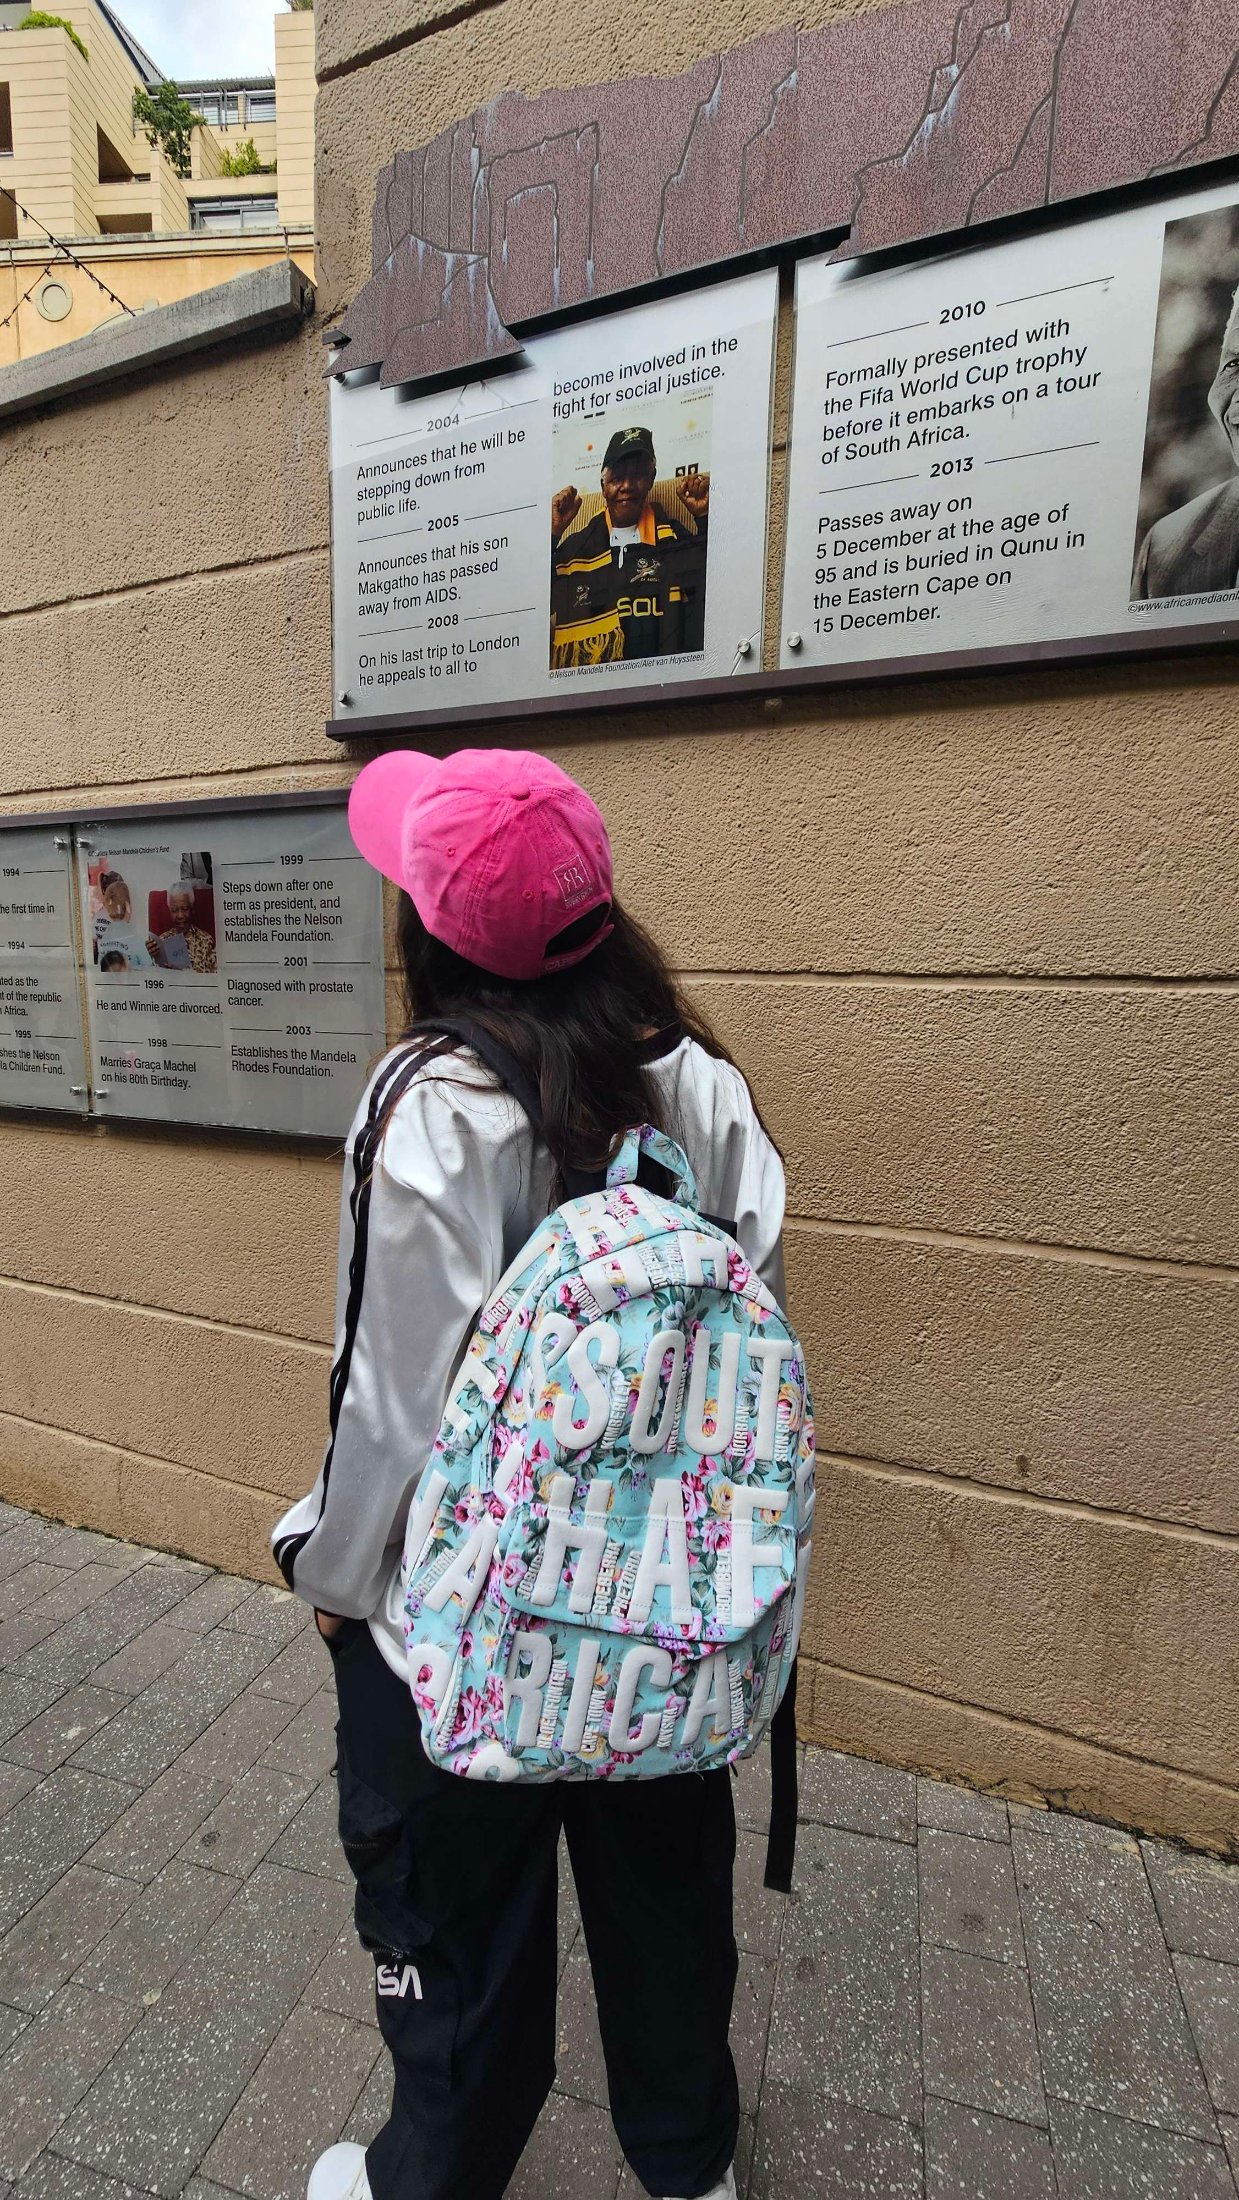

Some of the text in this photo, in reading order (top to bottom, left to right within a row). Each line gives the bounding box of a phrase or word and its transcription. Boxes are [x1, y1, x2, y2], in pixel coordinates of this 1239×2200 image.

[939, 300, 985, 325] 2010
[554, 338, 738, 396] become involved in the
[826, 319, 1069, 389] Formally presented with
[553, 396, 585, 419] fight
[590, 392, 611, 408] for
[616, 376, 661, 402] social
[666, 366, 724, 394] justice.
[824, 346, 1087, 415] the Fifa World Cup trophy
[823, 372, 1101, 441] before it embarks on a tour
[427, 413, 460, 432] 2004
[357, 430, 525, 480] Announces that he will be
[822, 426, 969, 464] of South Africa.
[930, 457, 973, 478] 2013
[357, 462, 484, 501] stepping down from
[358, 498, 420, 525] public life.
[428, 514, 459, 532] 2005
[819, 497, 972, 534] Passes away on
[816, 503, 1069, 559] 5 December at the age of
[358, 537, 508, 575] Announces that his son
[815, 533, 1084, 584] 95 and is buried in Qunu in
[359, 557, 498, 595] Makgatho has passed
[359, 586, 461, 616] away from AIDS.
[814, 571, 1011, 609] the Eastern Cape on
[428, 614, 458, 629] 2008
[814, 606, 940, 633] 15 December.
[359, 635, 519, 668] On his last trip to London
[360, 659, 477, 686] he appeals to all to
[281, 855, 303, 865] 1999
[223, 879, 333, 896] Steps down after one
[12, 904, 45, 914] first time
[224, 896, 340, 913] term president, and
[225, 913, 342, 926] establishes the Nelson
[8, 941, 25, 950] 1994
[225, 930, 333, 942] Mandela Foundation.
[284, 957, 307, 966] 2001
[26, 976, 38, 986] the
[145, 980, 164, 989] 1996
[228, 979, 353, 994] Diagnosed with prostate
[4, 1005, 28, 1016] Africa.
[16, 991, 61, 1003] the republic
[111, 1000, 223, 1014] and Winnie are divorced.
[228, 997, 263, 1006] cancer.
[15, 1030, 31, 1038] 1995
[148, 1038, 167, 1047] 1998
[286, 1026, 311, 1035] 2003
[9, 1061, 65, 1074] Children Fund.
[33, 1050, 59, 1061] Nelson
[100, 1056, 196, 1072] Marries Graça Machel
[232, 1045, 356, 1063] Establishes the Mandela
[114, 1072, 190, 1090] his 80th Birthday.
[232, 1060, 333, 1077] Rhodes Foundation.
[482, 1289, 518, 1333] DURBAN
[600, 1379, 632, 1450] KIMBERLEY
[732, 1405, 750, 1456] DURBAN
[774, 1404, 790, 1462] SUN CITY
[411, 1546, 459, 1599] PRETORIA
[611, 1550, 643, 1618] PRETORIA
[716, 1550, 732, 1626] MBOMBELA
[536, 1660, 568, 1748] BLOEMFONTEIN
[728, 1659, 744, 1730] KRUGER PARK
[581, 1689, 607, 1752] CAPE TOWN
[656, 1706, 679, 1748] KNYSNA
